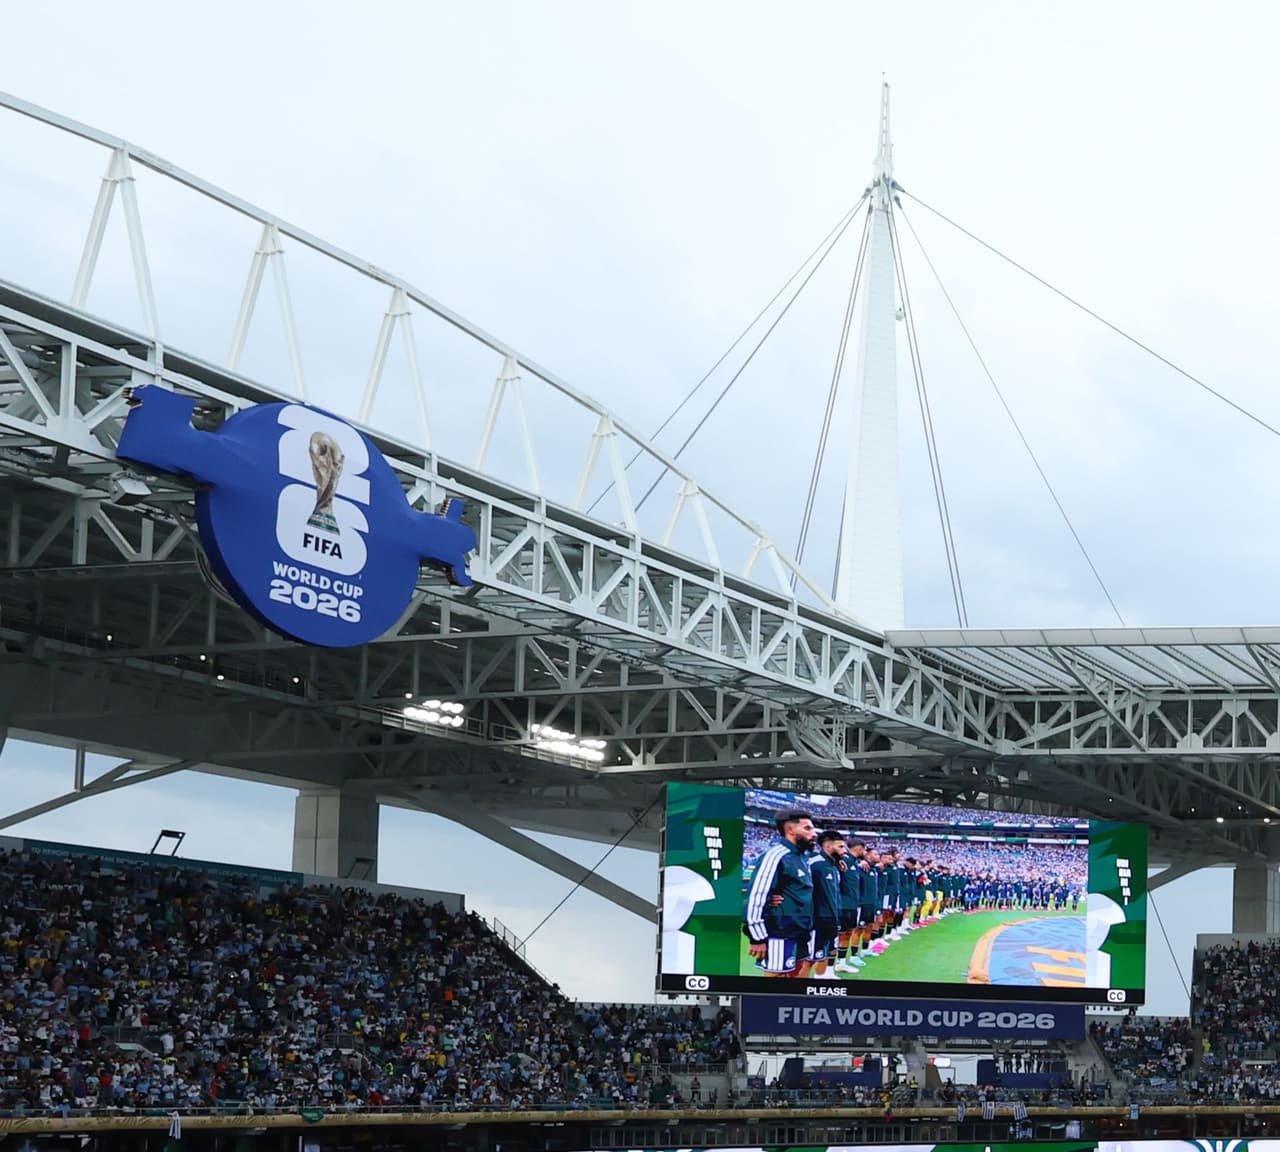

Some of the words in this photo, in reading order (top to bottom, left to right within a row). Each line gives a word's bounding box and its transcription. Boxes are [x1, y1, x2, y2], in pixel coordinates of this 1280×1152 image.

[303, 533, 343, 559] FIFA
[273, 561, 331, 591] WORLD
[332, 582, 364, 600] CUP
[269, 578, 361, 624] 2026
[688, 977, 706, 989] CC
[807, 986, 847, 997] PLEASE
[1109, 991, 1124, 1001] CC
[778, 1007, 831, 1025] FIFA
[836, 1009, 923, 1026] WORLD
[928, 1010, 974, 1028] CUP
[977, 1012, 1056, 1030] 2026
